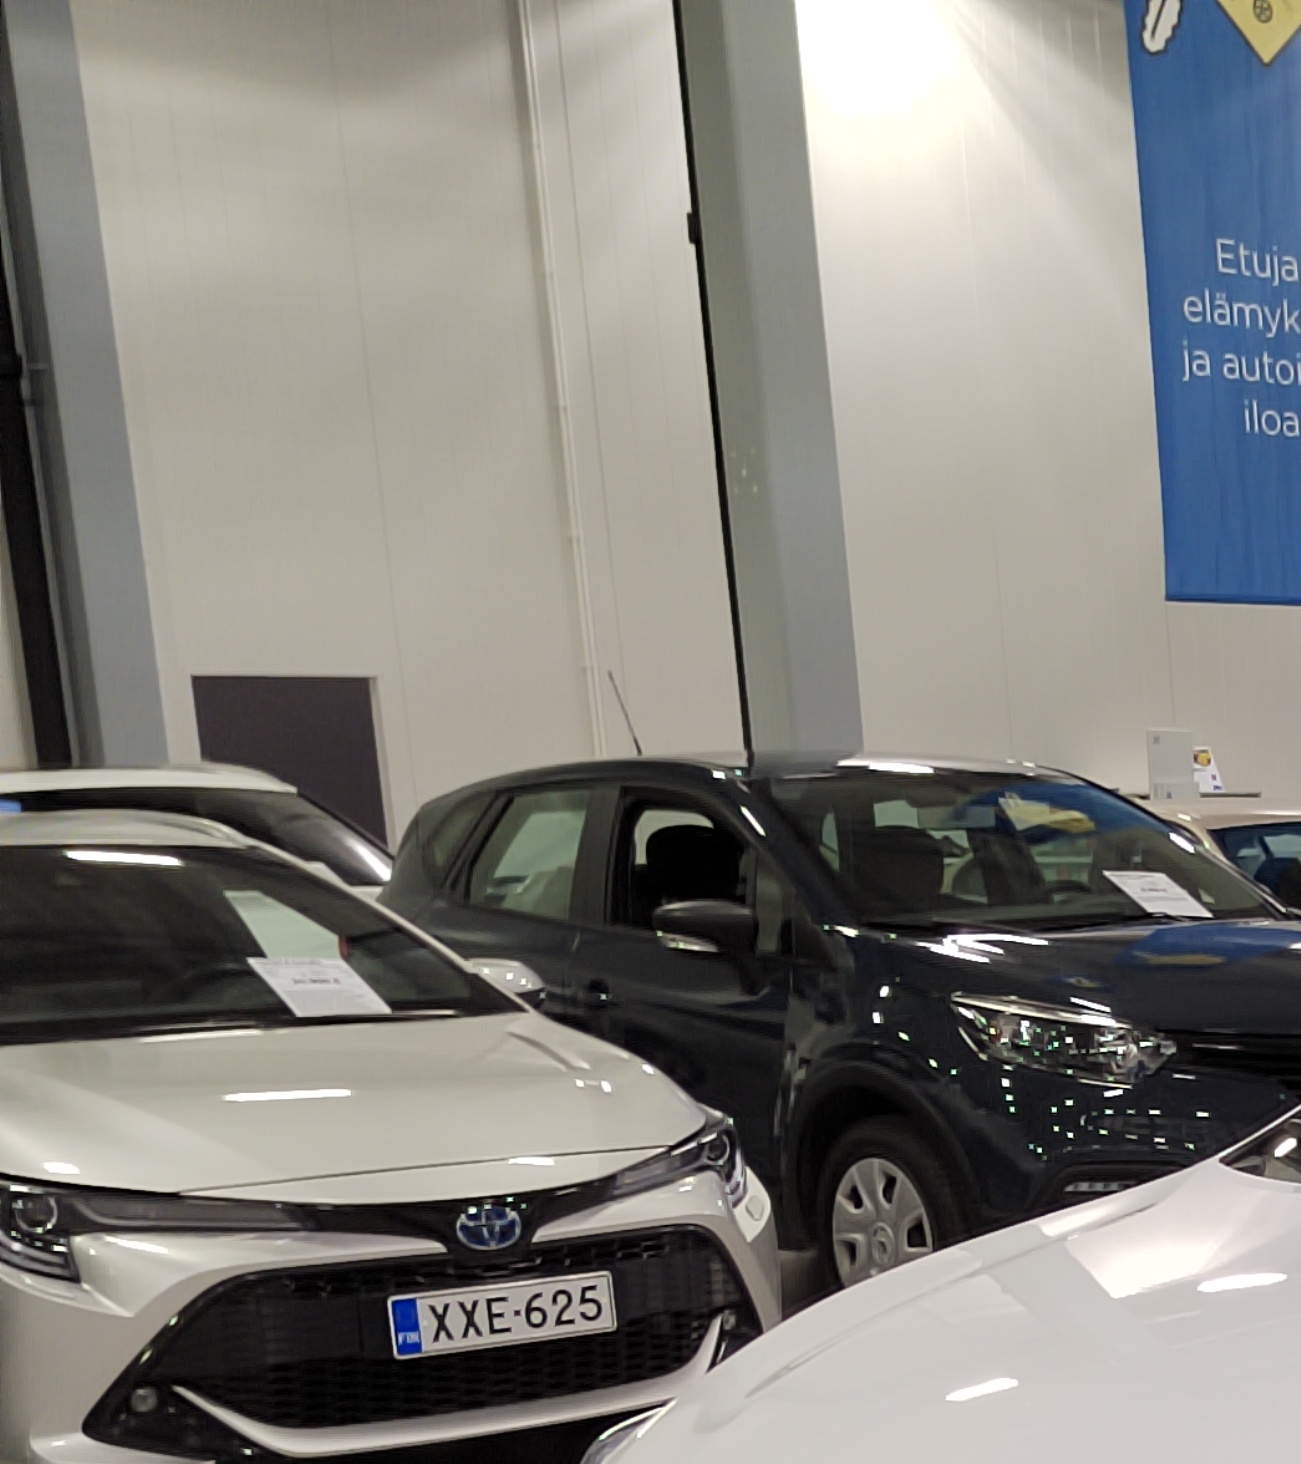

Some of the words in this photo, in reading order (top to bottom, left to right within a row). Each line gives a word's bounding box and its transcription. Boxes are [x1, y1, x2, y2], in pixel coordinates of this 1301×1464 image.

[1182, 339, 1211, 382] ja
[1243, 398, 1301, 438] iloa
[428, 1284, 603, 1344] XXE-625
